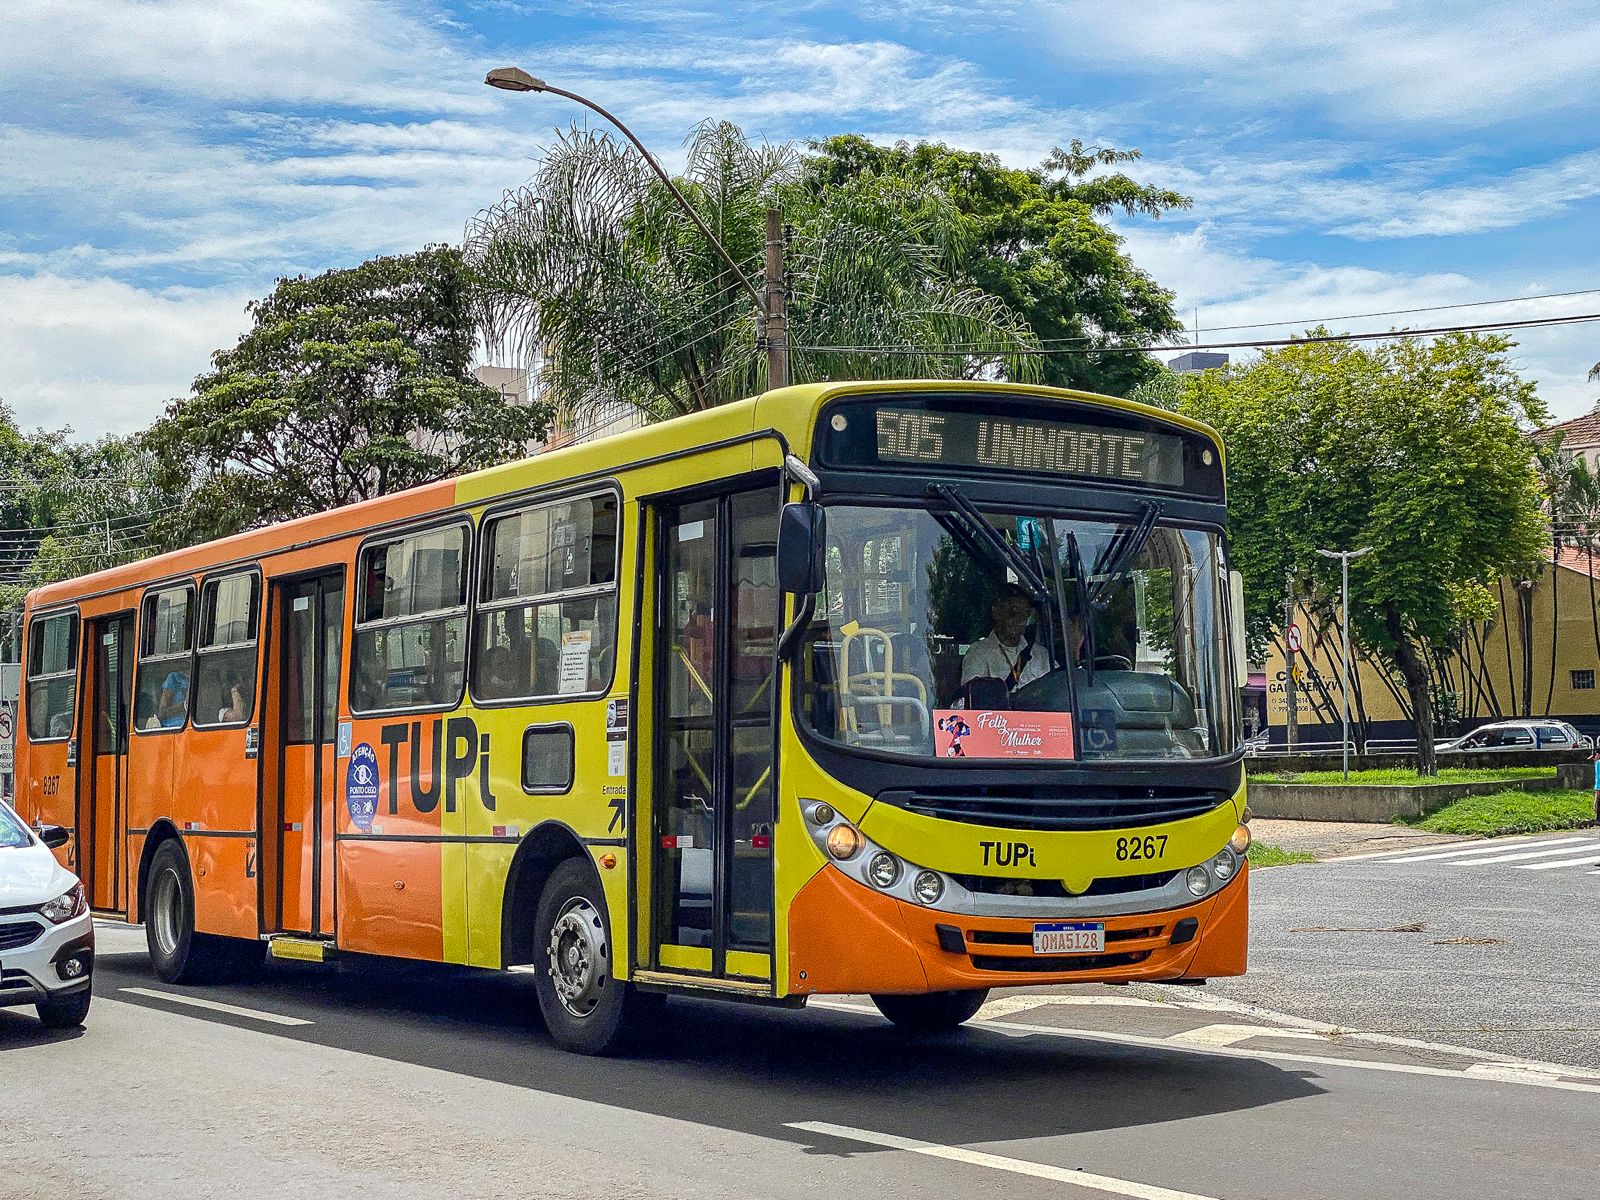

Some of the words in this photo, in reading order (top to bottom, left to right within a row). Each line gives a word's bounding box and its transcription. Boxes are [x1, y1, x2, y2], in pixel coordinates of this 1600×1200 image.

[876, 411, 945, 459] 505
[977, 421, 1144, 477] UNINORTE
[977, 712, 1008, 734] Feliz
[1000, 731, 1043, 747] Mulher
[352, 746, 375, 763] ATENÇÃO
[381, 716, 496, 815] TUPi
[43, 775, 60, 795] 8267
[350, 786, 364, 795] PONTO
[365, 786, 377, 794] CEGO
[602, 785, 626, 795] Entrada
[979, 841, 1036, 867] TUPi
[1115, 835, 1168, 861] 8267
